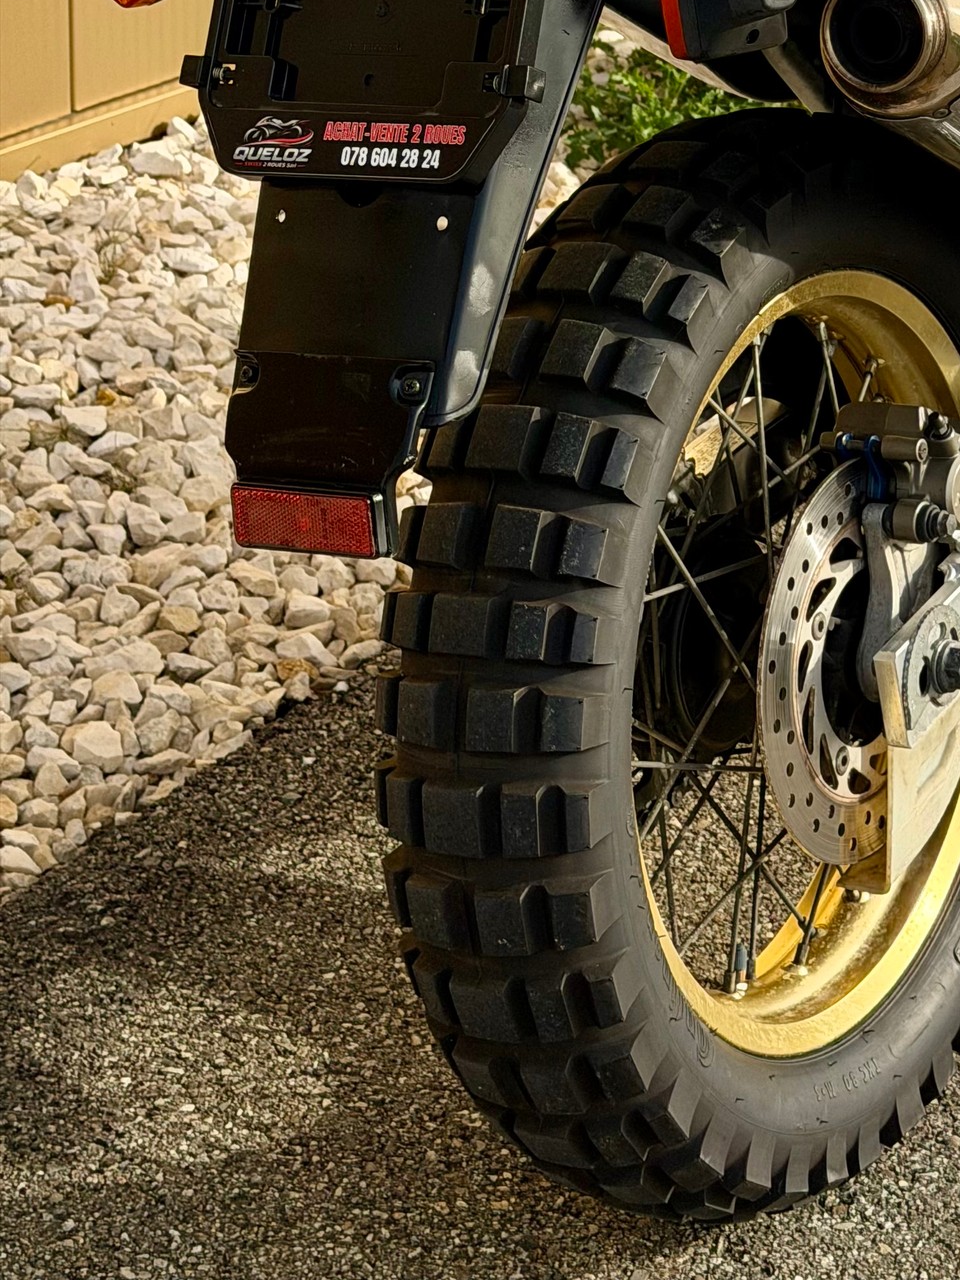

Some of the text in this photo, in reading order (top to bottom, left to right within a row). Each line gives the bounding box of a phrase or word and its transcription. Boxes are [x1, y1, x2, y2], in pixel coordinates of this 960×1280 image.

[323, 121, 466, 145] ACHAT-VENTE 2 ROUES
[232, 146, 313, 162] QUELOZ
[341, 146, 440, 169] 078 604 28 24
